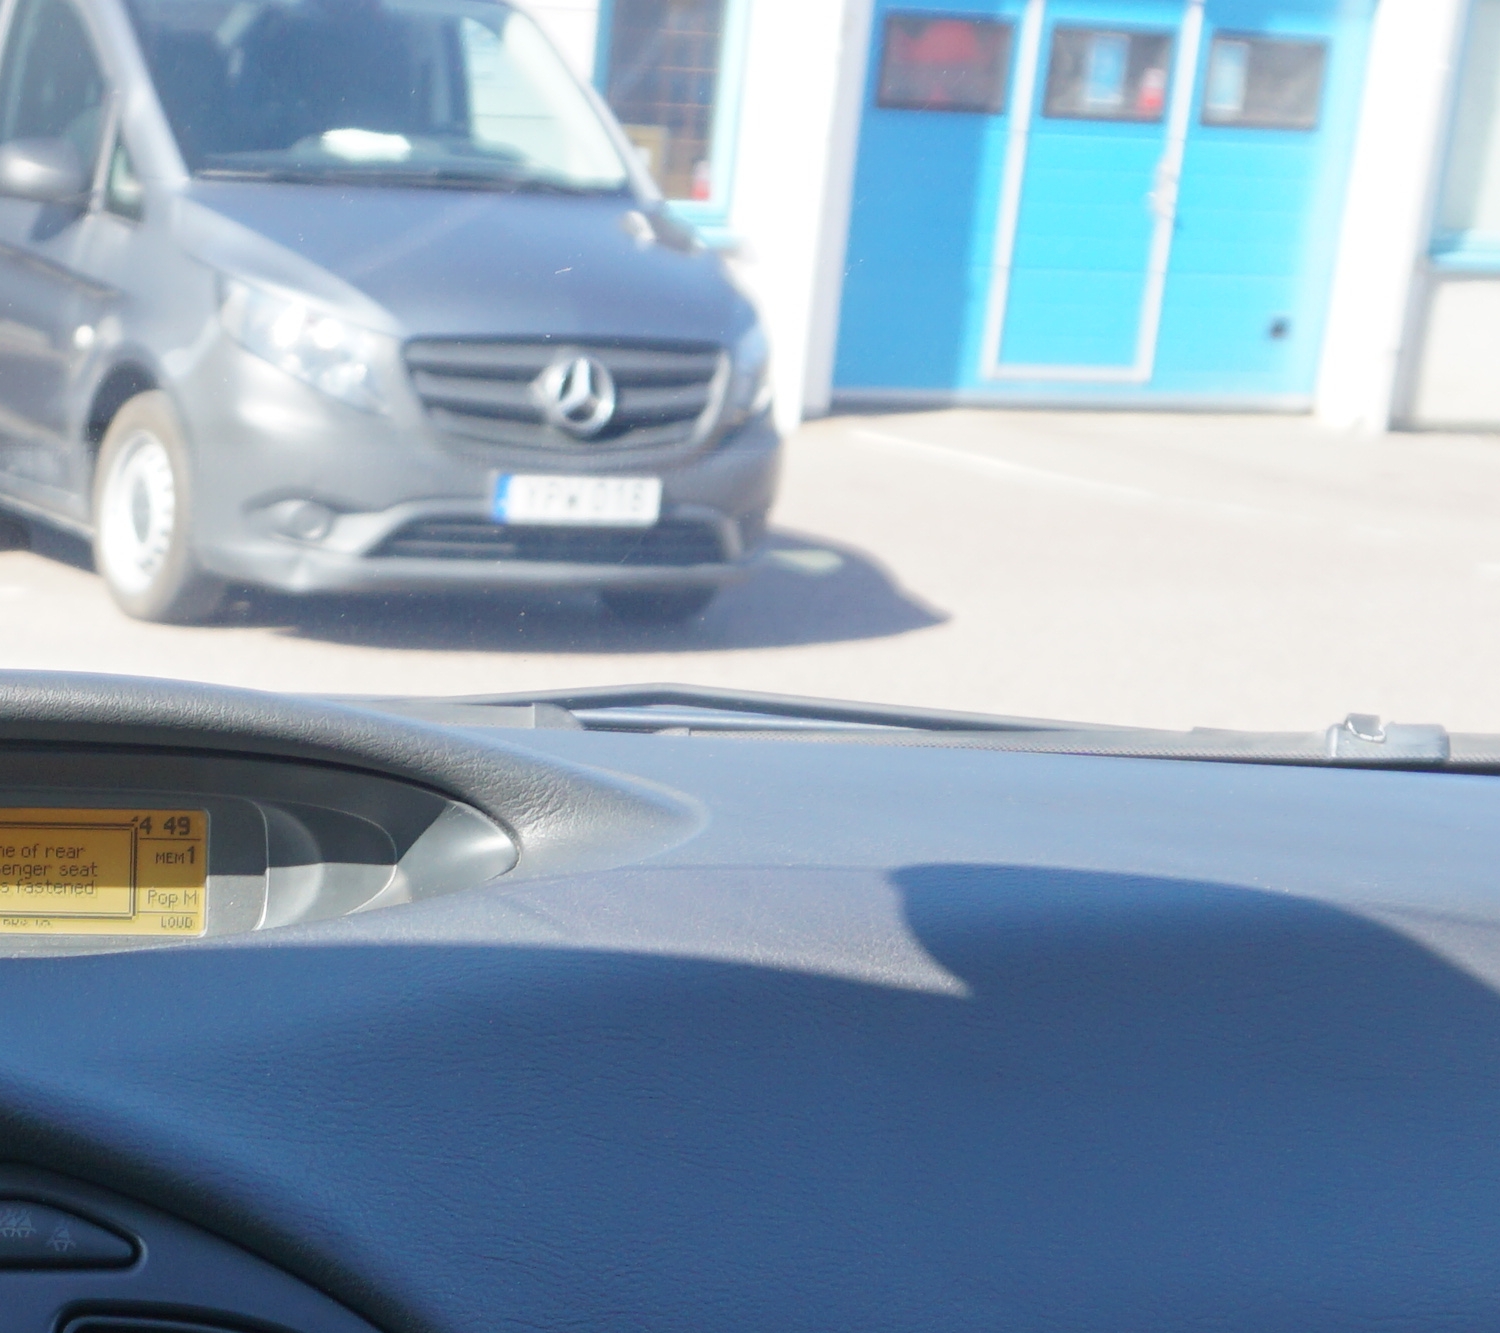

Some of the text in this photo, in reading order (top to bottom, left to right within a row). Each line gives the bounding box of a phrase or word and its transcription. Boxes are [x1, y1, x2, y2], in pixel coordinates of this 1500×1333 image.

[163, 816, 191, 836] 49
[21, 843, 41, 859] of
[45, 845, 85, 859] rear
[59, 863, 98, 877] seat
[16, 879, 95, 895] fastened
[147, 889, 178, 908] Pop
[160, 917, 193, 929] LOUD
